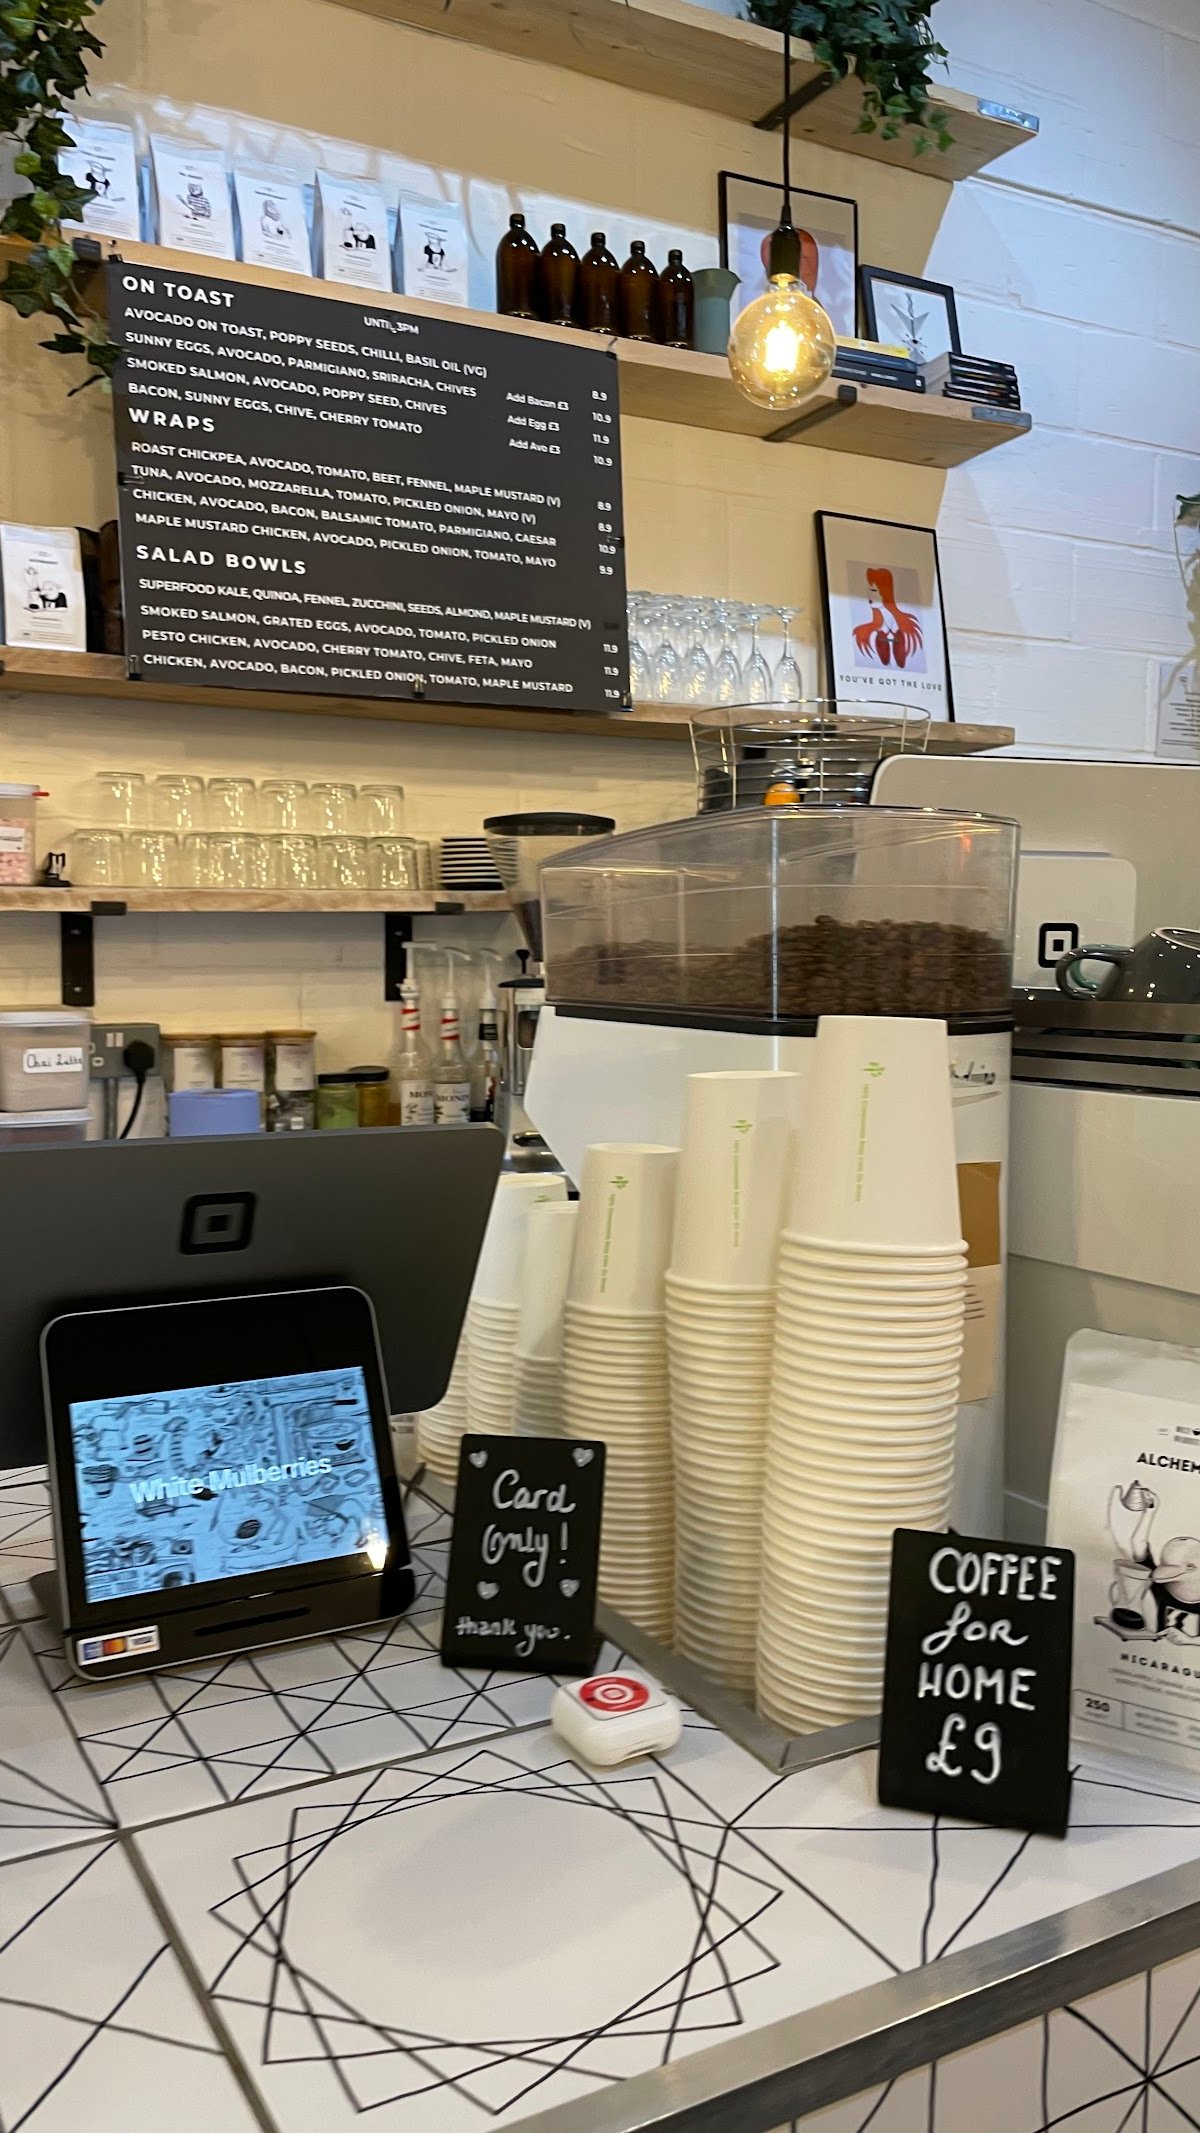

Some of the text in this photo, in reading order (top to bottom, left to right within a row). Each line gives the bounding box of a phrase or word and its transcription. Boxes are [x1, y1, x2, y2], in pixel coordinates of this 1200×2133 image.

[123, 275, 233, 307] ON TOAST
[124, 307, 486, 378] AVOCADO ON TOAST, POPPY SEEDS, CHILLI, BASIL OIL (VG)
[125, 331, 476, 396] SUNNY EGGS, AVOCADO, PARMIGIANO, SRIRACHA, CHIVES
[126, 357, 446, 414] SMOKED SALMON, AVOCADO, POPPY SEED, CHIVES
[505, 392, 569, 410] Add Bacon £3
[592, 390, 608, 402] 8.9
[128, 382, 422, 433] BACON, SUNNY EGGS, CHIVE, CHERRY TOMATO
[128, 407, 214, 432] WRAPS
[506, 415, 559, 431] Add Egg £3
[592, 412, 612, 424] 10.9
[508, 438, 560, 454] Add Avo £3
[592, 433, 610, 444] 11.9
[131, 441, 560, 507] ROAST CHICKPEA, AVOCADO, TOMATO, BEET, FENNEL, MAPLE MUSTARD (V)
[594, 455, 612, 466] 10.9
[130, 464, 536, 524] TUNA, AVOCADO, MOZZARELLA, TOMATO, PICKLED ONION, MAYO (V)
[597, 501, 612, 512] 8.9
[132, 488, 556, 546] CHICKEN, AVOCADO, BACON, BALSAMIC TOMATO, PARMIGIANO, CAESAR
[598, 522, 612, 532] 8.9
[135, 512, 556, 567] MAPLE MUSTARD CHICKEN, AVOCADO, PICKLED ONION, TOMATO, MAYO
[598, 544, 616, 554] 10.9
[136, 545, 305, 574] SALAD BOWLS
[599, 566, 613, 576] 9.9
[138, 578, 215, 594] SUPERFOOD
[494, 611, 528, 622] MAPLE
[529, 614, 576, 627] MUSTARD
[578, 618, 591, 630] (V)
[140, 605, 556, 648] SMOKED SALMON, GRATED EGGS, AVOCADO, TOMATO, PICKLED ONION
[142, 629, 532, 668] PESTO CHICKEN, AVOCADO, CHERRY TOMATO, CHIVE, FETA, MAYO
[603, 644, 618, 654] 11.9
[142, 653, 206, 668] CHICKEN,
[209, 659, 277, 673] AVOCADO,
[280, 663, 328, 677] BACON,
[330, 667, 382, 679] PICKLED
[428, 674, 480, 687] TOMATO,
[482, 678, 519, 689] MAPLE
[522, 680, 573, 692] MUSTARD
[604, 666, 619, 676] 11.9
[879, 678, 897, 686] GOT
[902, 680, 918, 688] THE
[922, 683, 942, 692] LOVE
[604, 689, 620, 698] 11.9
[130, 1456, 332, 1503] White Mulberries
[493, 1469, 576, 1514] Card
[929, 1547, 1062, 1600] COFFEE
[918, 1662, 1037, 1710] HOME
[925, 1713, 1001, 1784] £9
